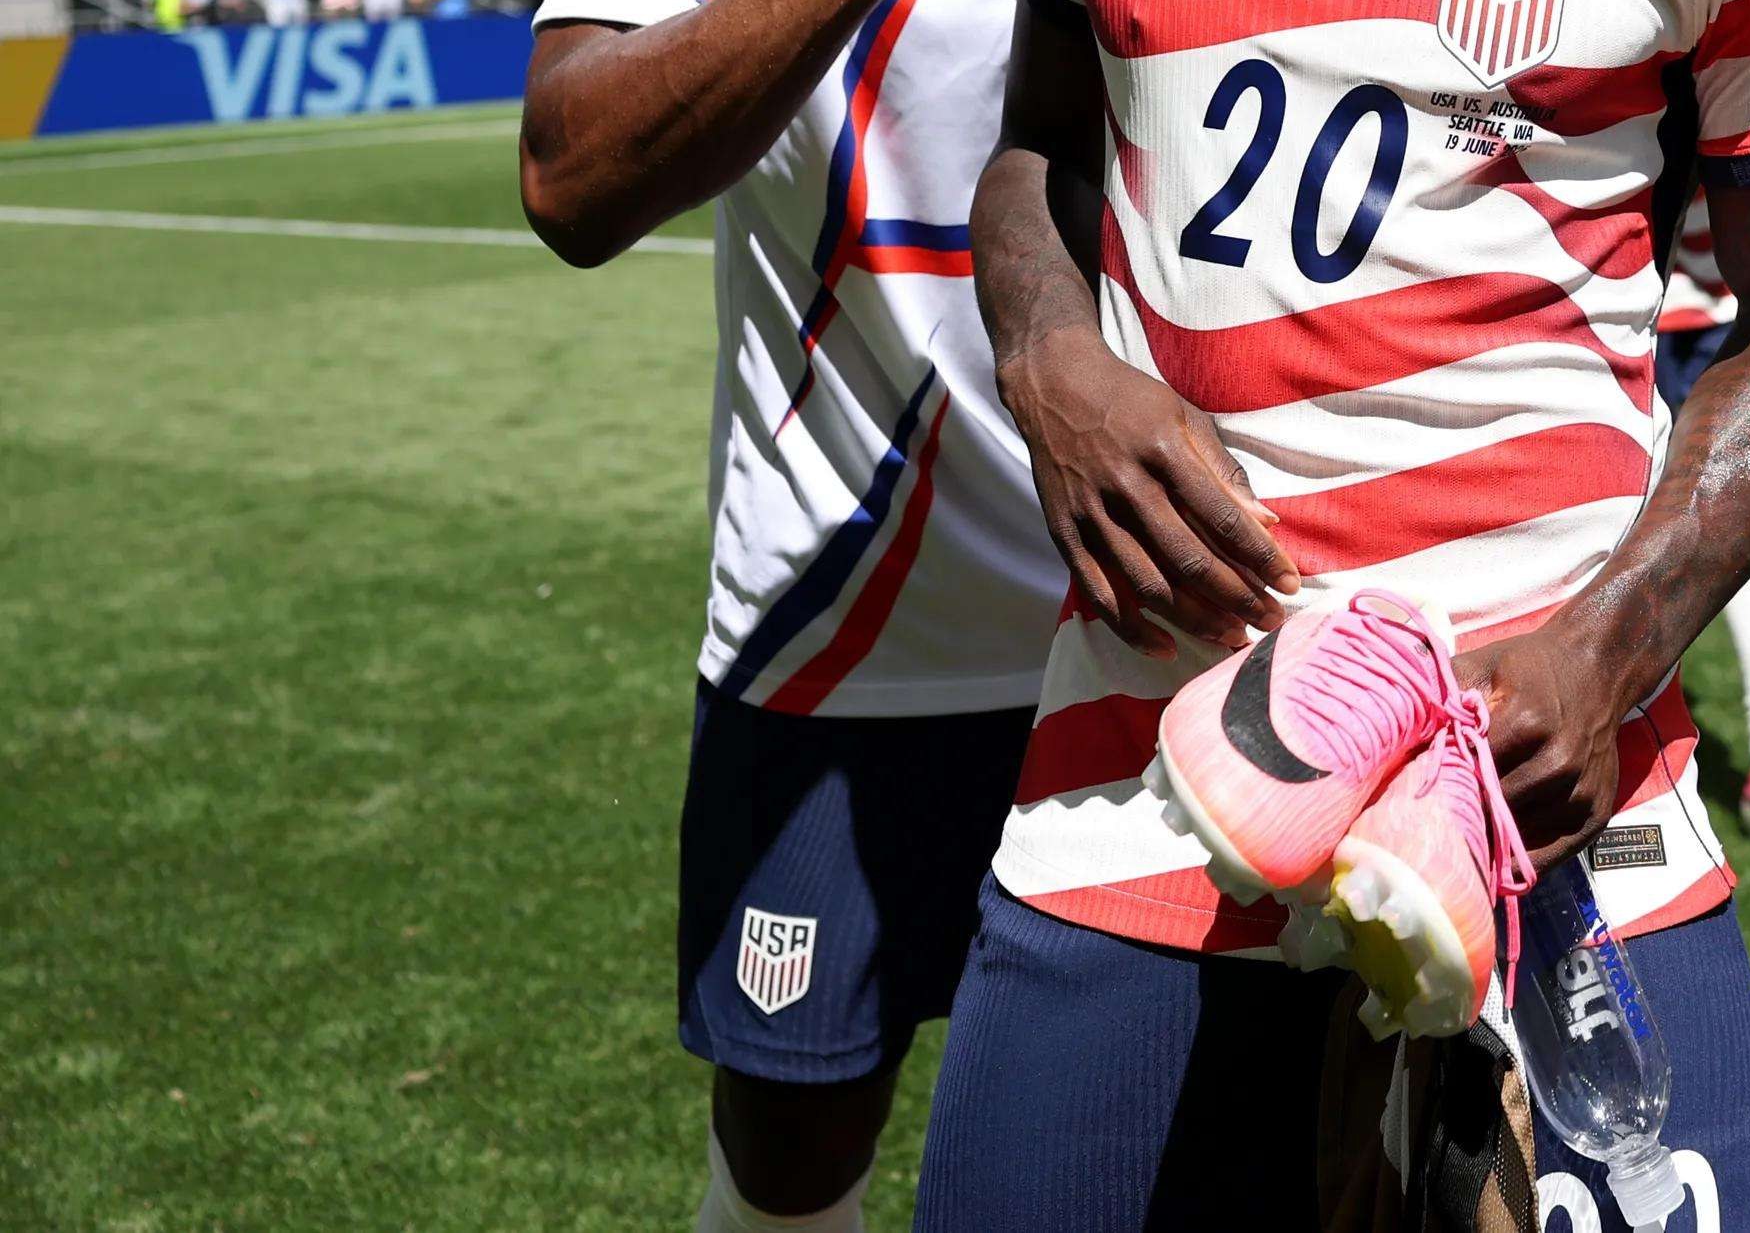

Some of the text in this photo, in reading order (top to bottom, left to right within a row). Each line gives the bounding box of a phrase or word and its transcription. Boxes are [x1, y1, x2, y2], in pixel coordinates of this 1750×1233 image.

[174, 17, 437, 122] VISA
[1430, 91, 1458, 109] USA
[1463, 96, 1482, 114] VS.
[1448, 113, 1534, 141] SEATTLE, WA
[1445, 133, 1459, 150] 19
[1462, 137, 1499, 158] JUNE
[1179, 58, 1409, 284] 20
[748, 915, 810, 957] USA
